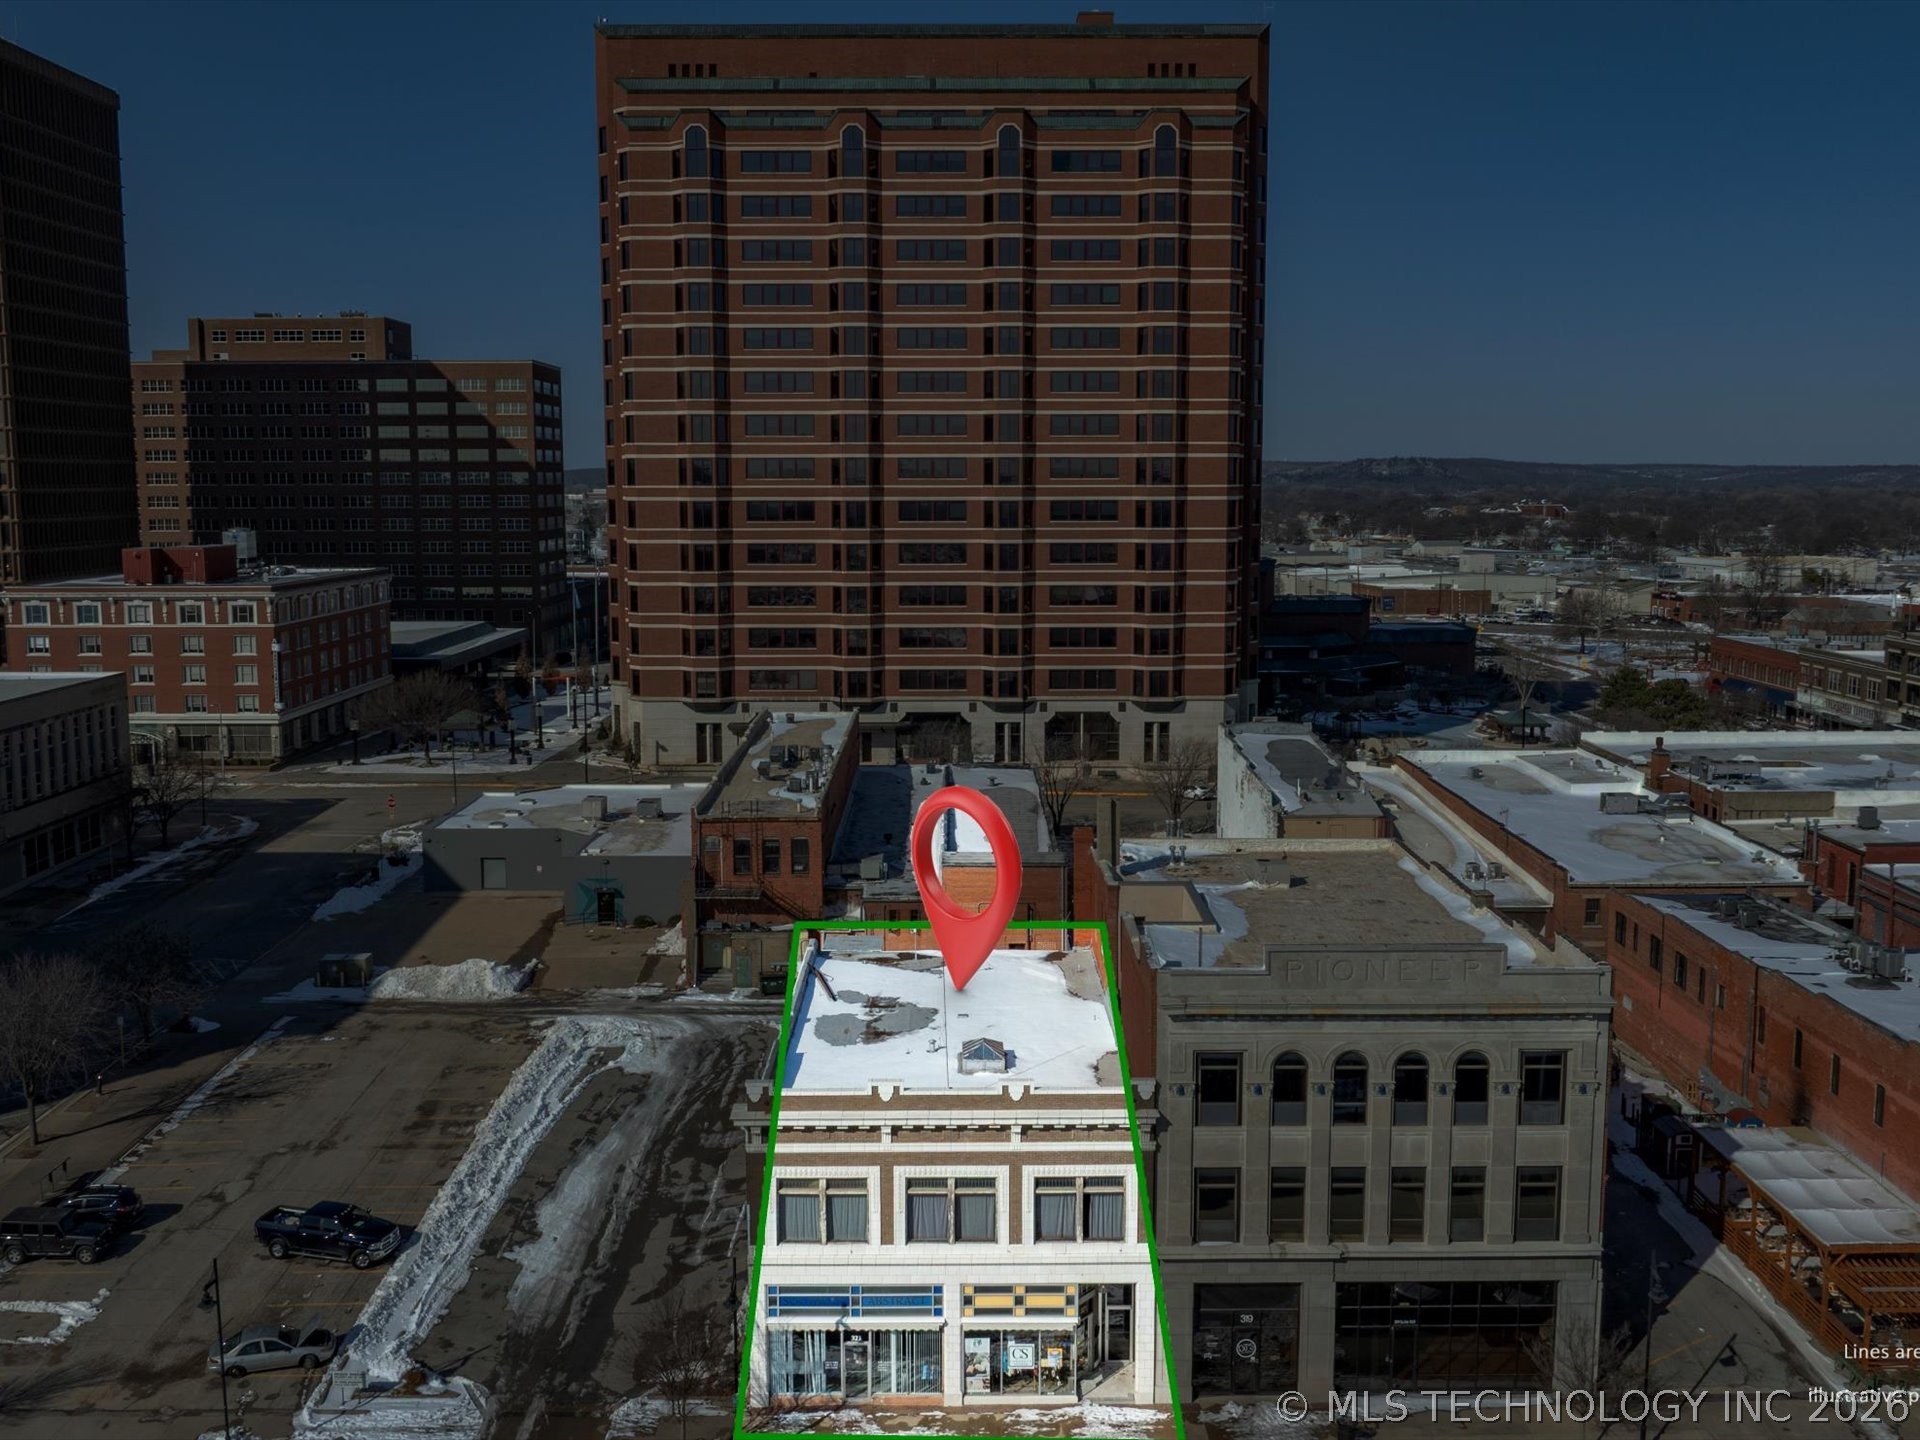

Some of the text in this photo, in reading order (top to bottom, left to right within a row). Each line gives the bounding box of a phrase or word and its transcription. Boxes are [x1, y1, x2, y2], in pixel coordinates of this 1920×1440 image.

[1286, 957, 1482, 983] PIONEER
[868, 1295, 926, 1306] ABSTRACT
[1012, 1348, 1029, 1360] CS
